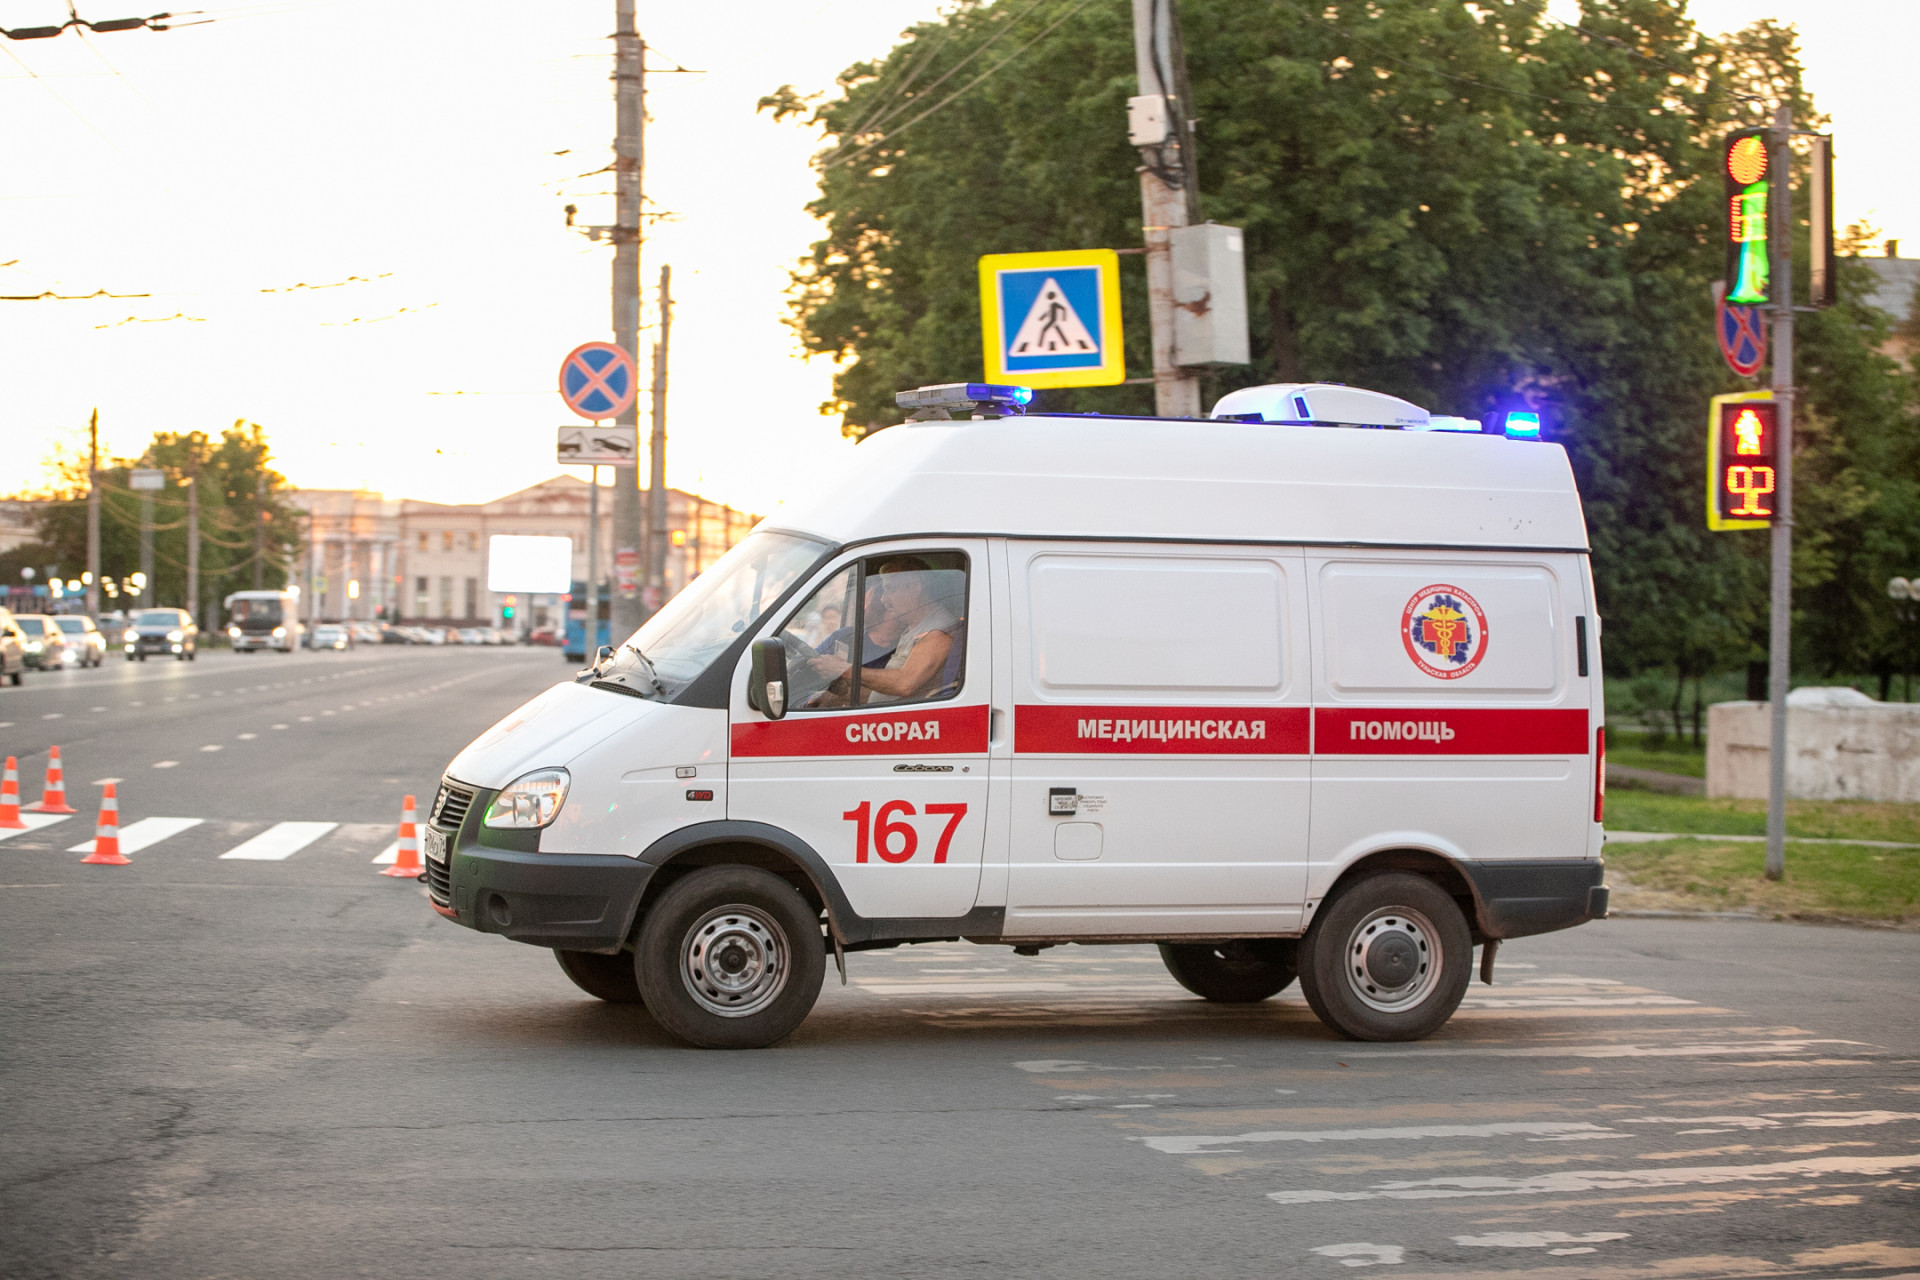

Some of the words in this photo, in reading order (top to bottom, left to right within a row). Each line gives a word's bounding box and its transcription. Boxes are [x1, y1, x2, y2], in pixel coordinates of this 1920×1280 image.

[1453, 588, 1483, 617] КАТАСТРОФ
[1417, 660, 1447, 678] ТУЛЬСКАЯ
[1450, 662, 1476, 678] ОБЛАСТЬ
[845, 720, 940, 742] СКОРАЯ
[1077, 719, 1266, 743] МЕДИЦИНСКАЯ
[1350, 721, 1456, 744] ПОМОЩЬ
[687, 791, 712, 800] 4WD
[843, 800, 968, 863] 167
